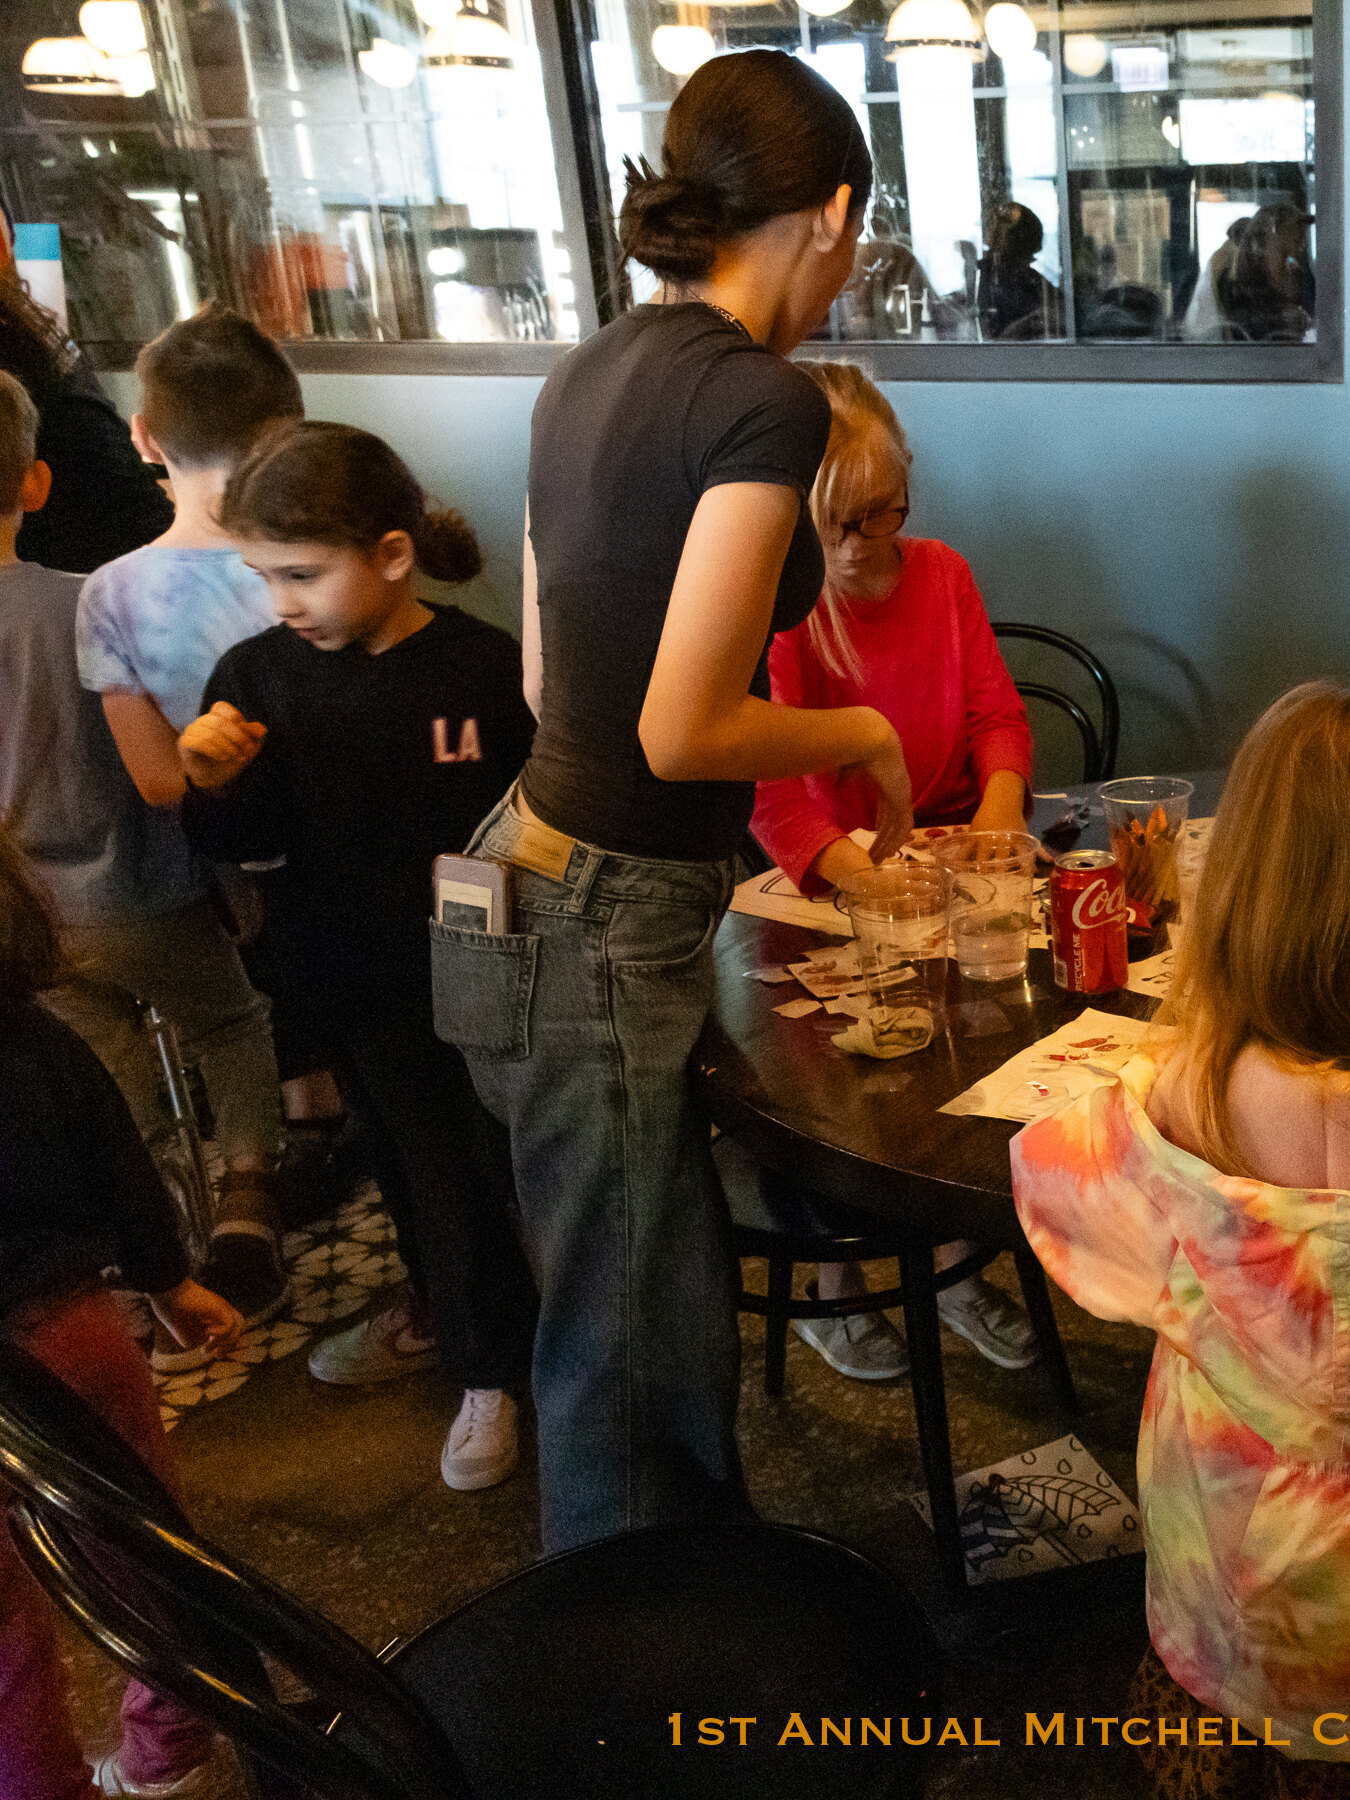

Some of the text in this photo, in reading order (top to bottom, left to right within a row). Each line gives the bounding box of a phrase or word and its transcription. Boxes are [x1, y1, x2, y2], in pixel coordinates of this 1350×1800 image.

[433, 717, 481, 762] LA
[1073, 933, 1083, 992] RECYCLE ME
